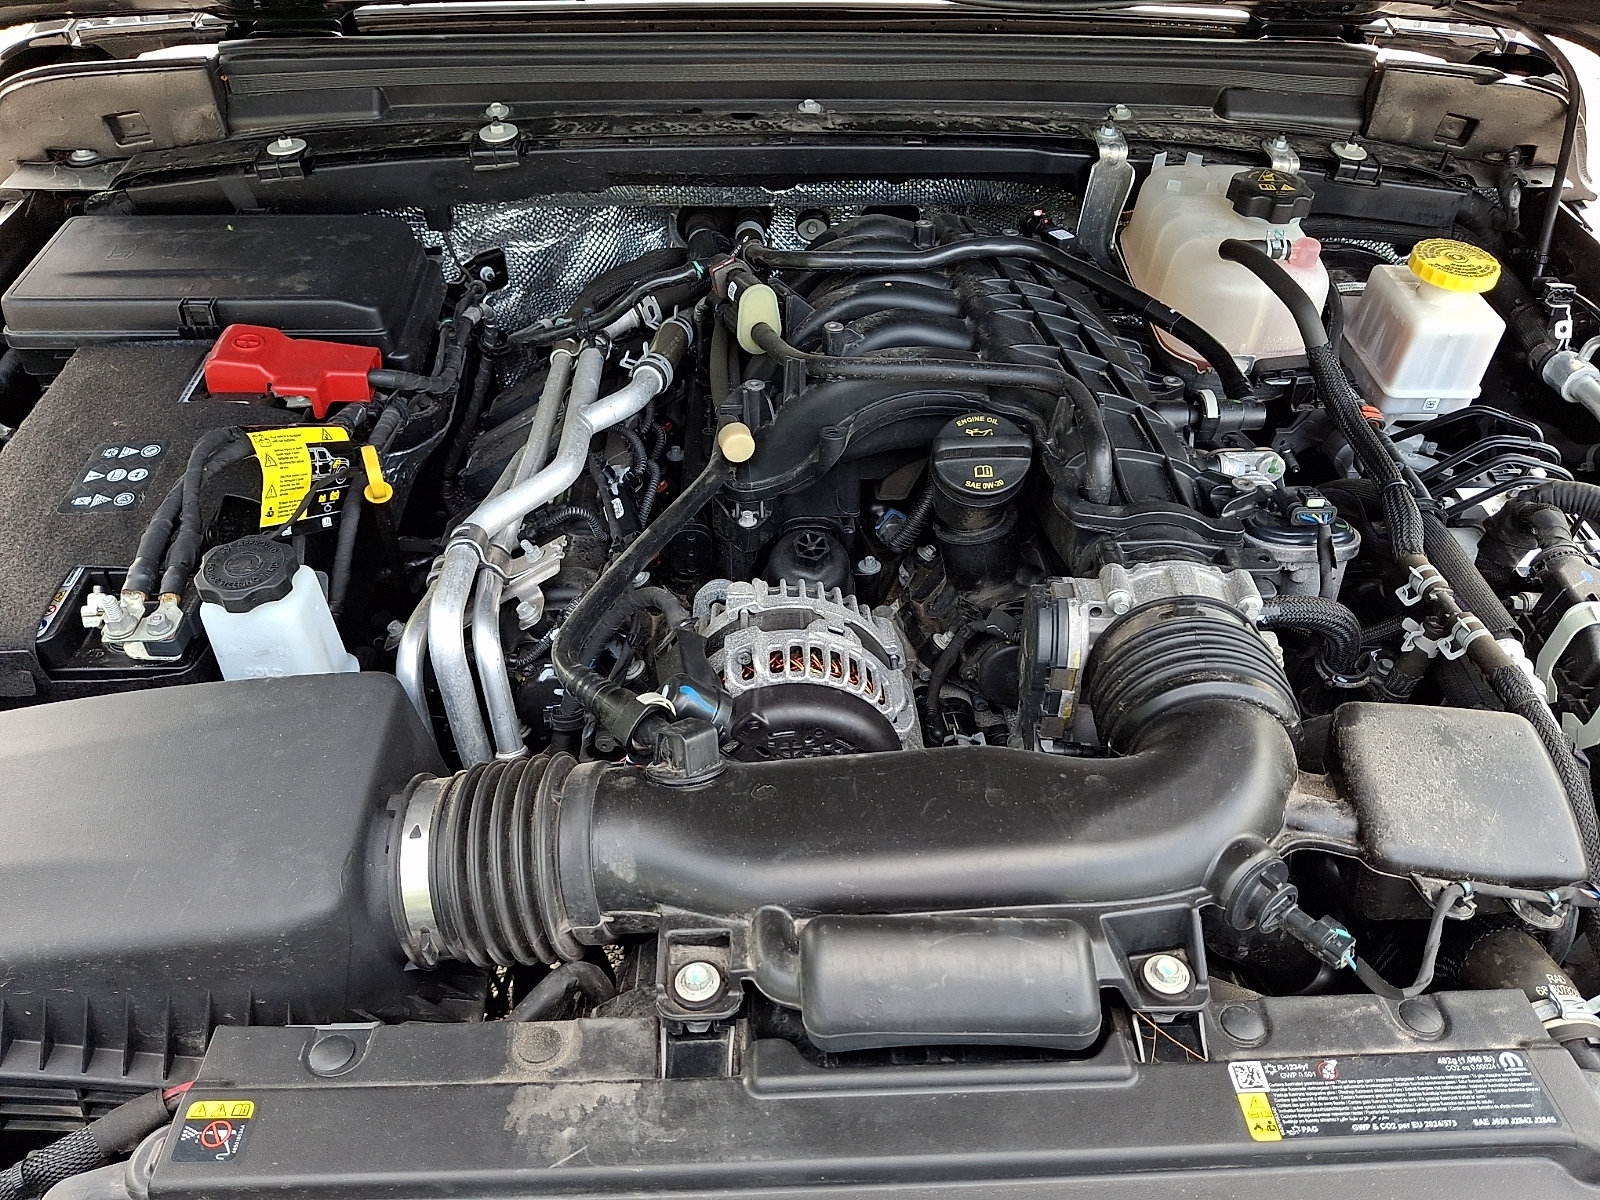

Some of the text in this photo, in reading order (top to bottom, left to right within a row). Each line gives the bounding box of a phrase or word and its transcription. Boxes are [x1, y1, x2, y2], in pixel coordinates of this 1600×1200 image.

[956, 416, 999, 427] ENGINE OIL
[965, 479, 1005, 490] SAE 0W-20
[1545, 973, 1567, 985] RAD
[1301, 1125, 1319, 1133] PAG
[1351, 1123, 1371, 1132] GWP
[1380, 1122, 1397, 1130] CO2
[1411, 1120, 1424, 1129] EU
